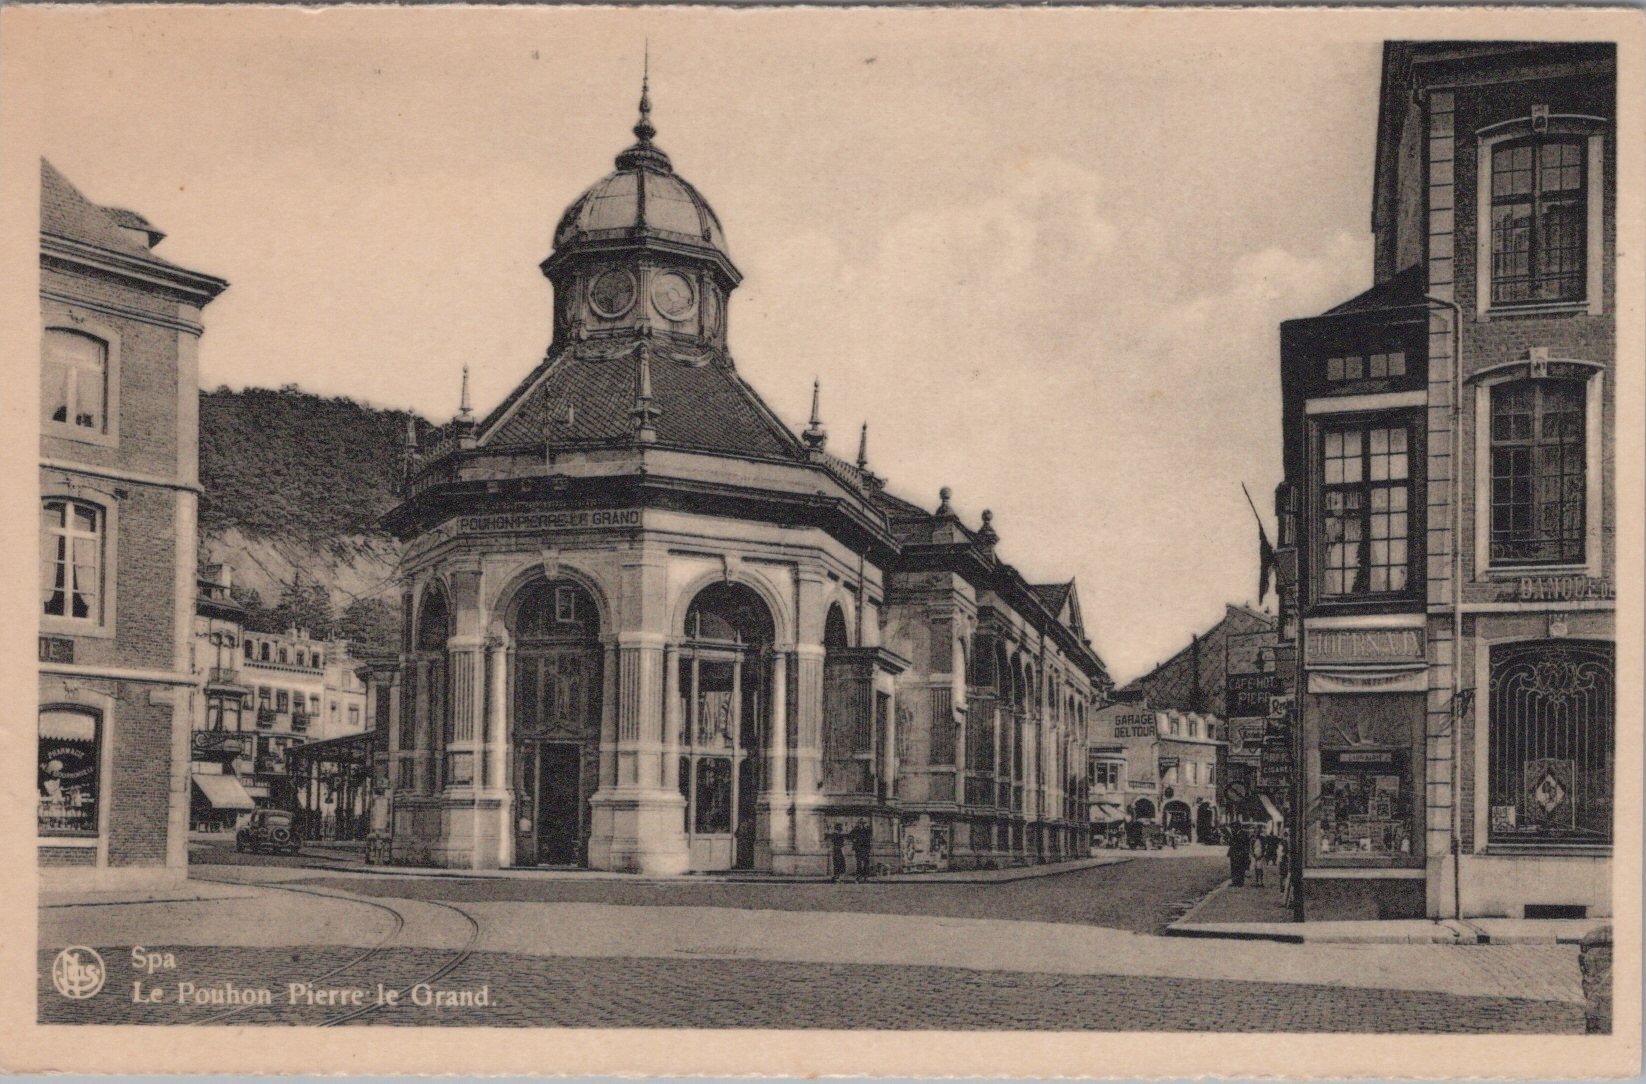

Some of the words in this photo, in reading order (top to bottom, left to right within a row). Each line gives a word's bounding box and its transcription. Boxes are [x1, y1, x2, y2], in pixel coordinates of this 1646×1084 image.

[592, 510, 640, 525] GRAND
[1520, 575, 1600, 600] BANQUE
[1309, 630, 1424, 659] JOURNAUX
[1115, 714, 1154, 726] GARAGE
